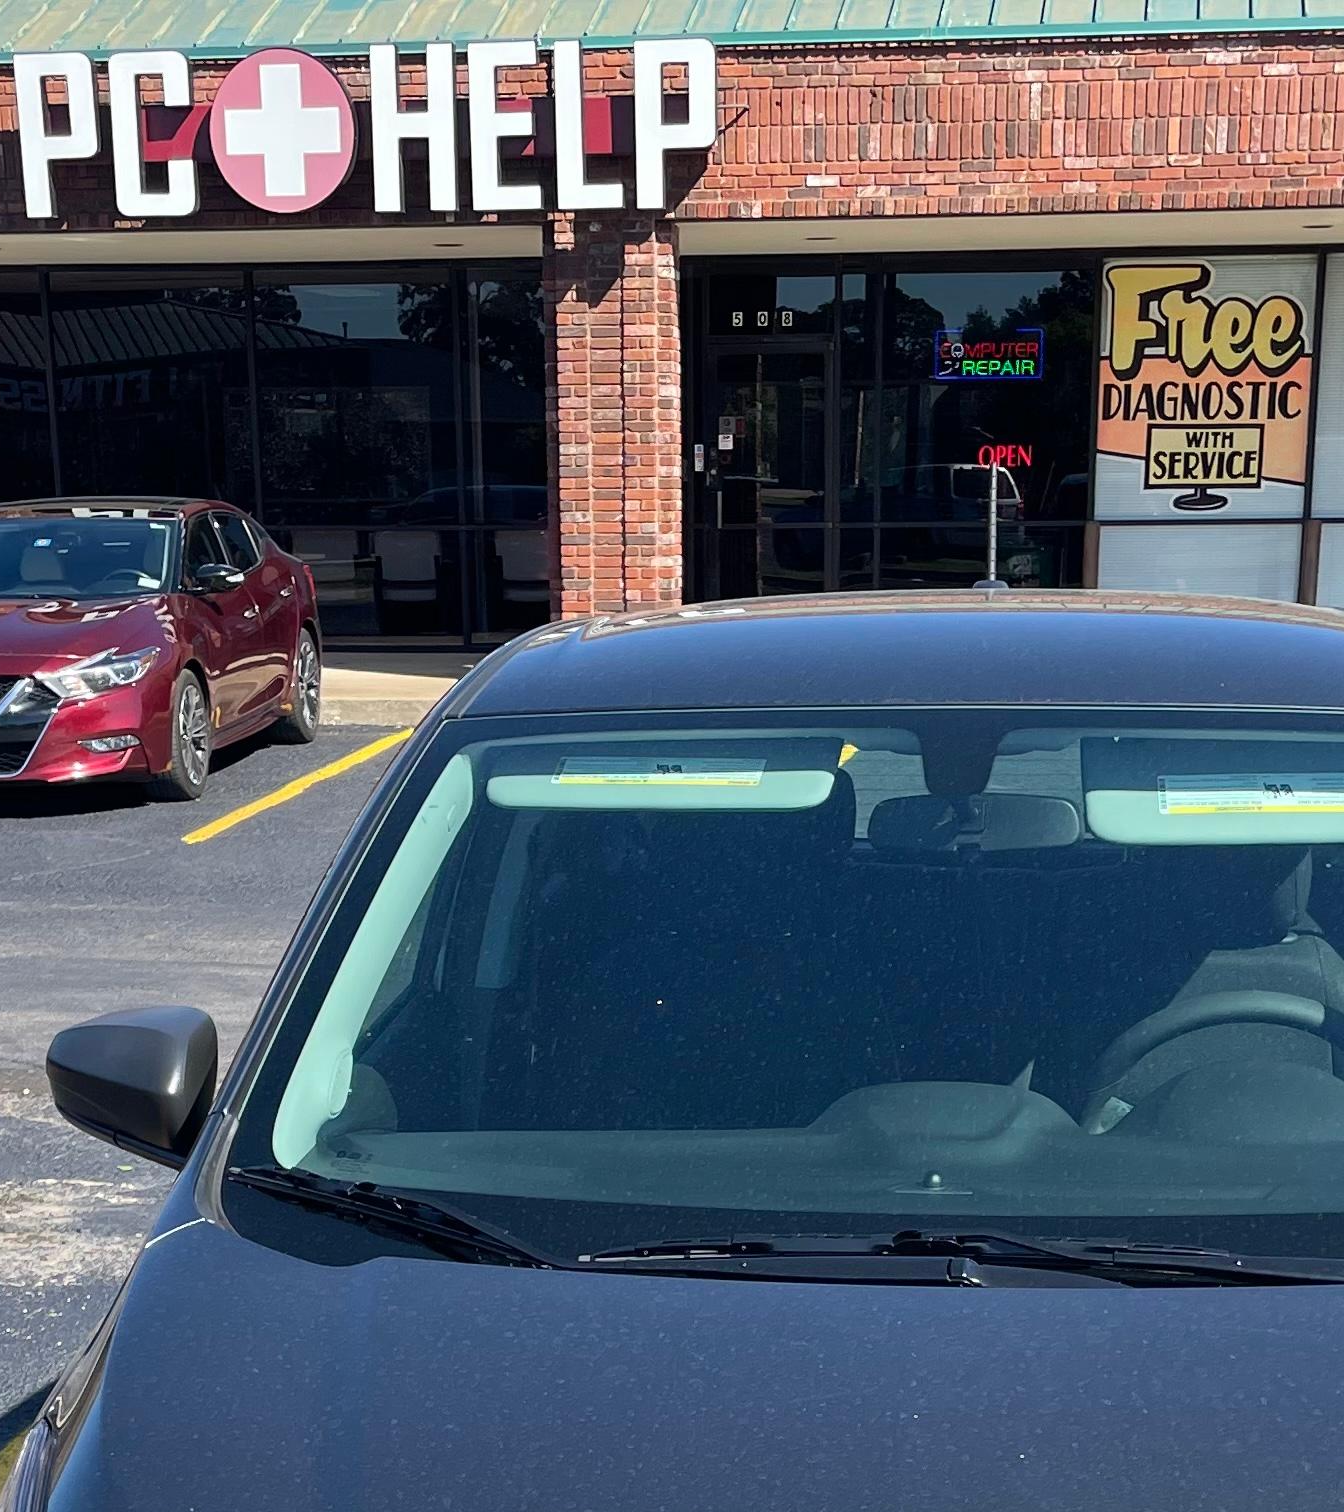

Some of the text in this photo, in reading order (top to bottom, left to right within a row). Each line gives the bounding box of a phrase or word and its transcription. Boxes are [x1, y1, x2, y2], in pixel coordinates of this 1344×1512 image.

[13, 39, 717, 218] PC HELP
[1106, 263, 1304, 381] Free
[962, 359, 1035, 376] REPAIR
[1102, 381, 1303, 421] DIAGNOSTIC
[978, 444, 1033, 467] OPEN
[1185, 431, 1234, 449] WITH
[1152, 450, 1257, 481] SERVICE
